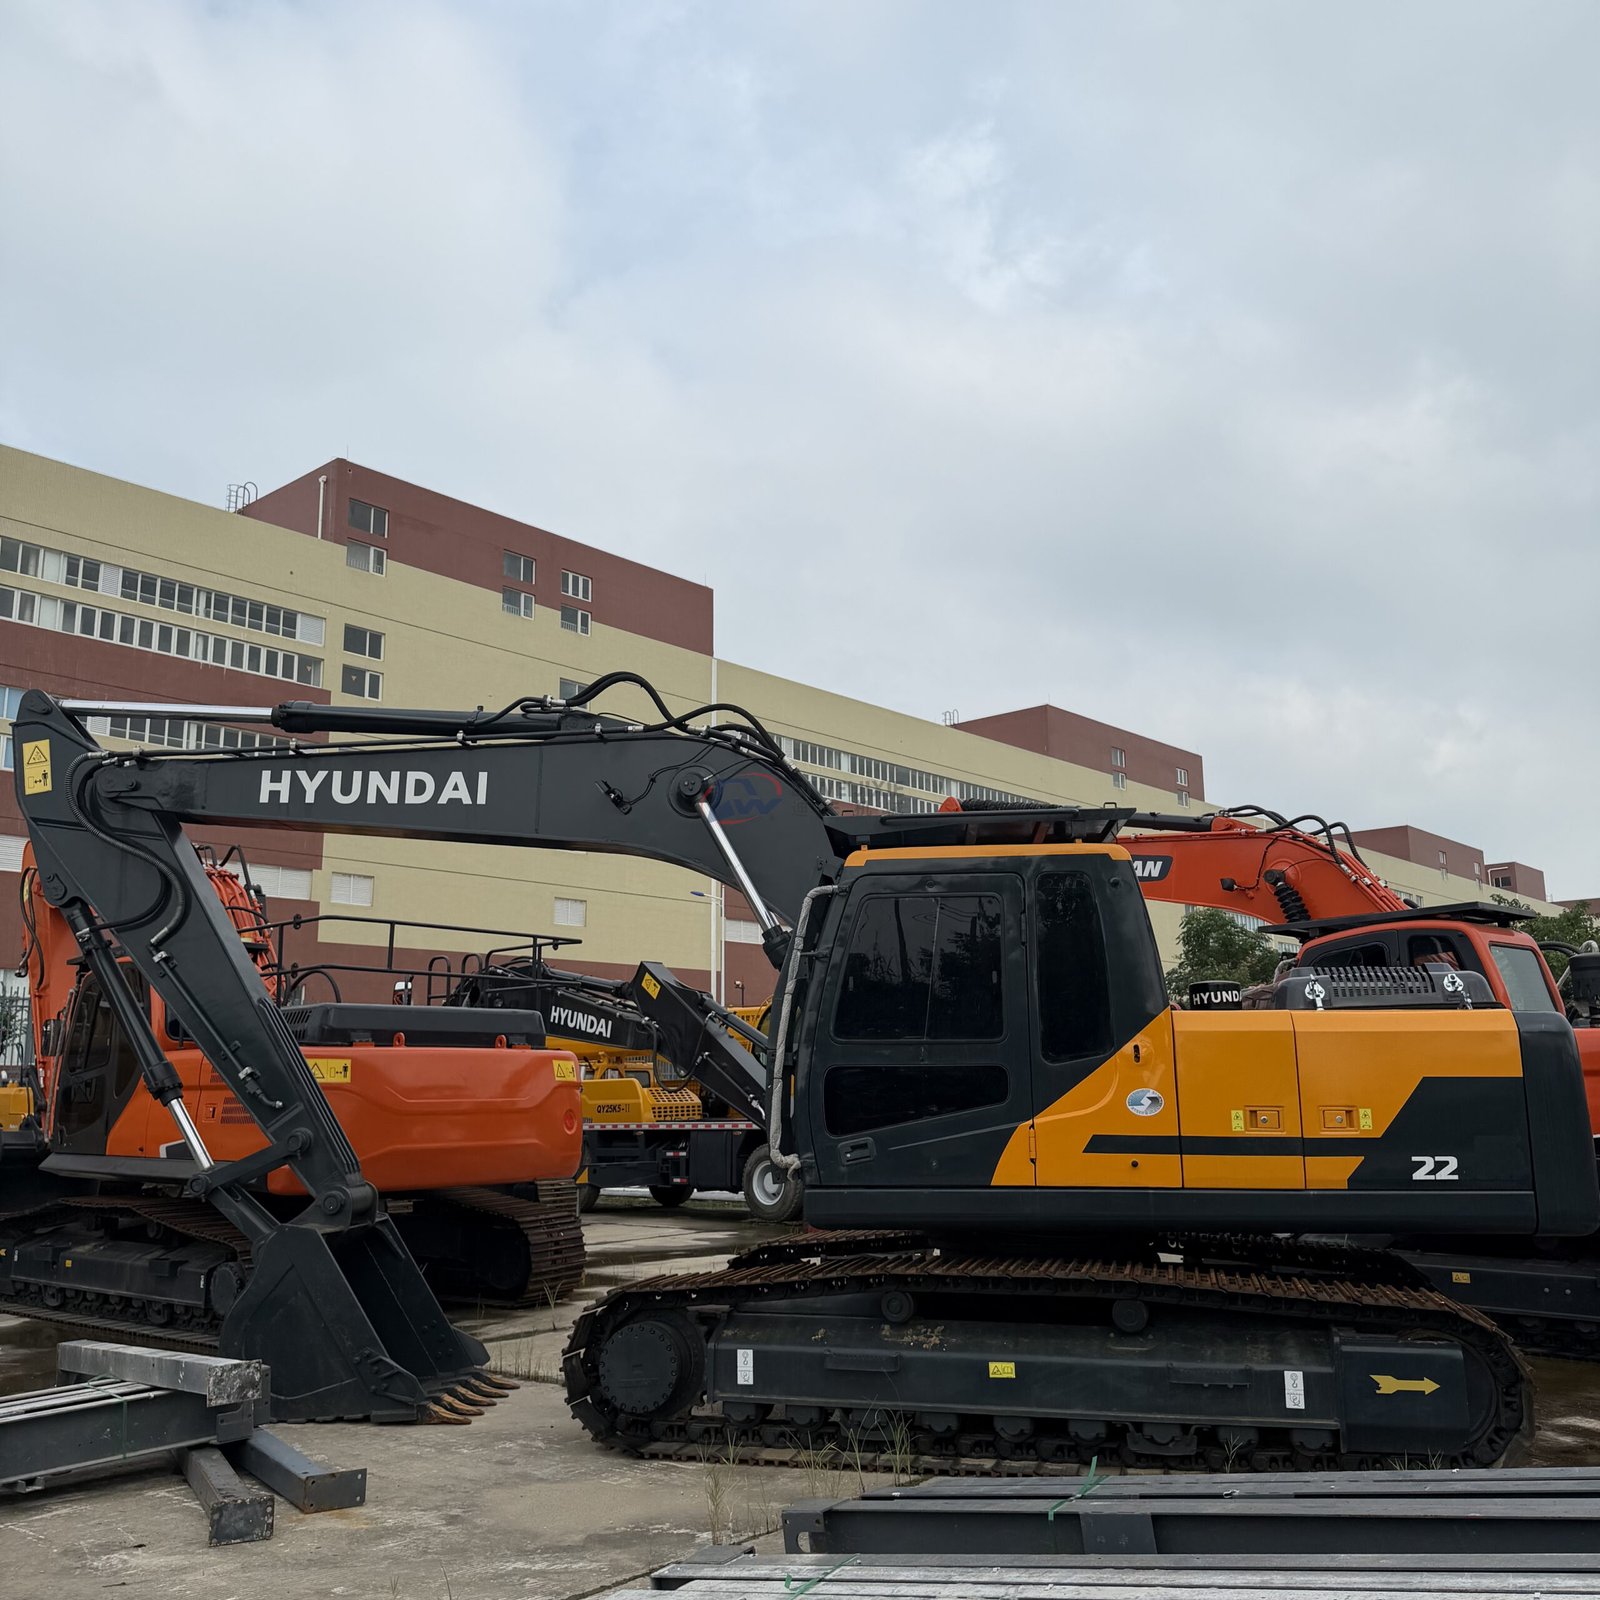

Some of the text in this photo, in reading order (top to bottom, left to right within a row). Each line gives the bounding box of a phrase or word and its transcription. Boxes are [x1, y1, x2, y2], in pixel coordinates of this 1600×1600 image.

[259, 769, 488, 805] HYUNDAI
[550, 1005, 613, 1039] HYUNDAI
[1411, 1155, 1459, 1180] 22
